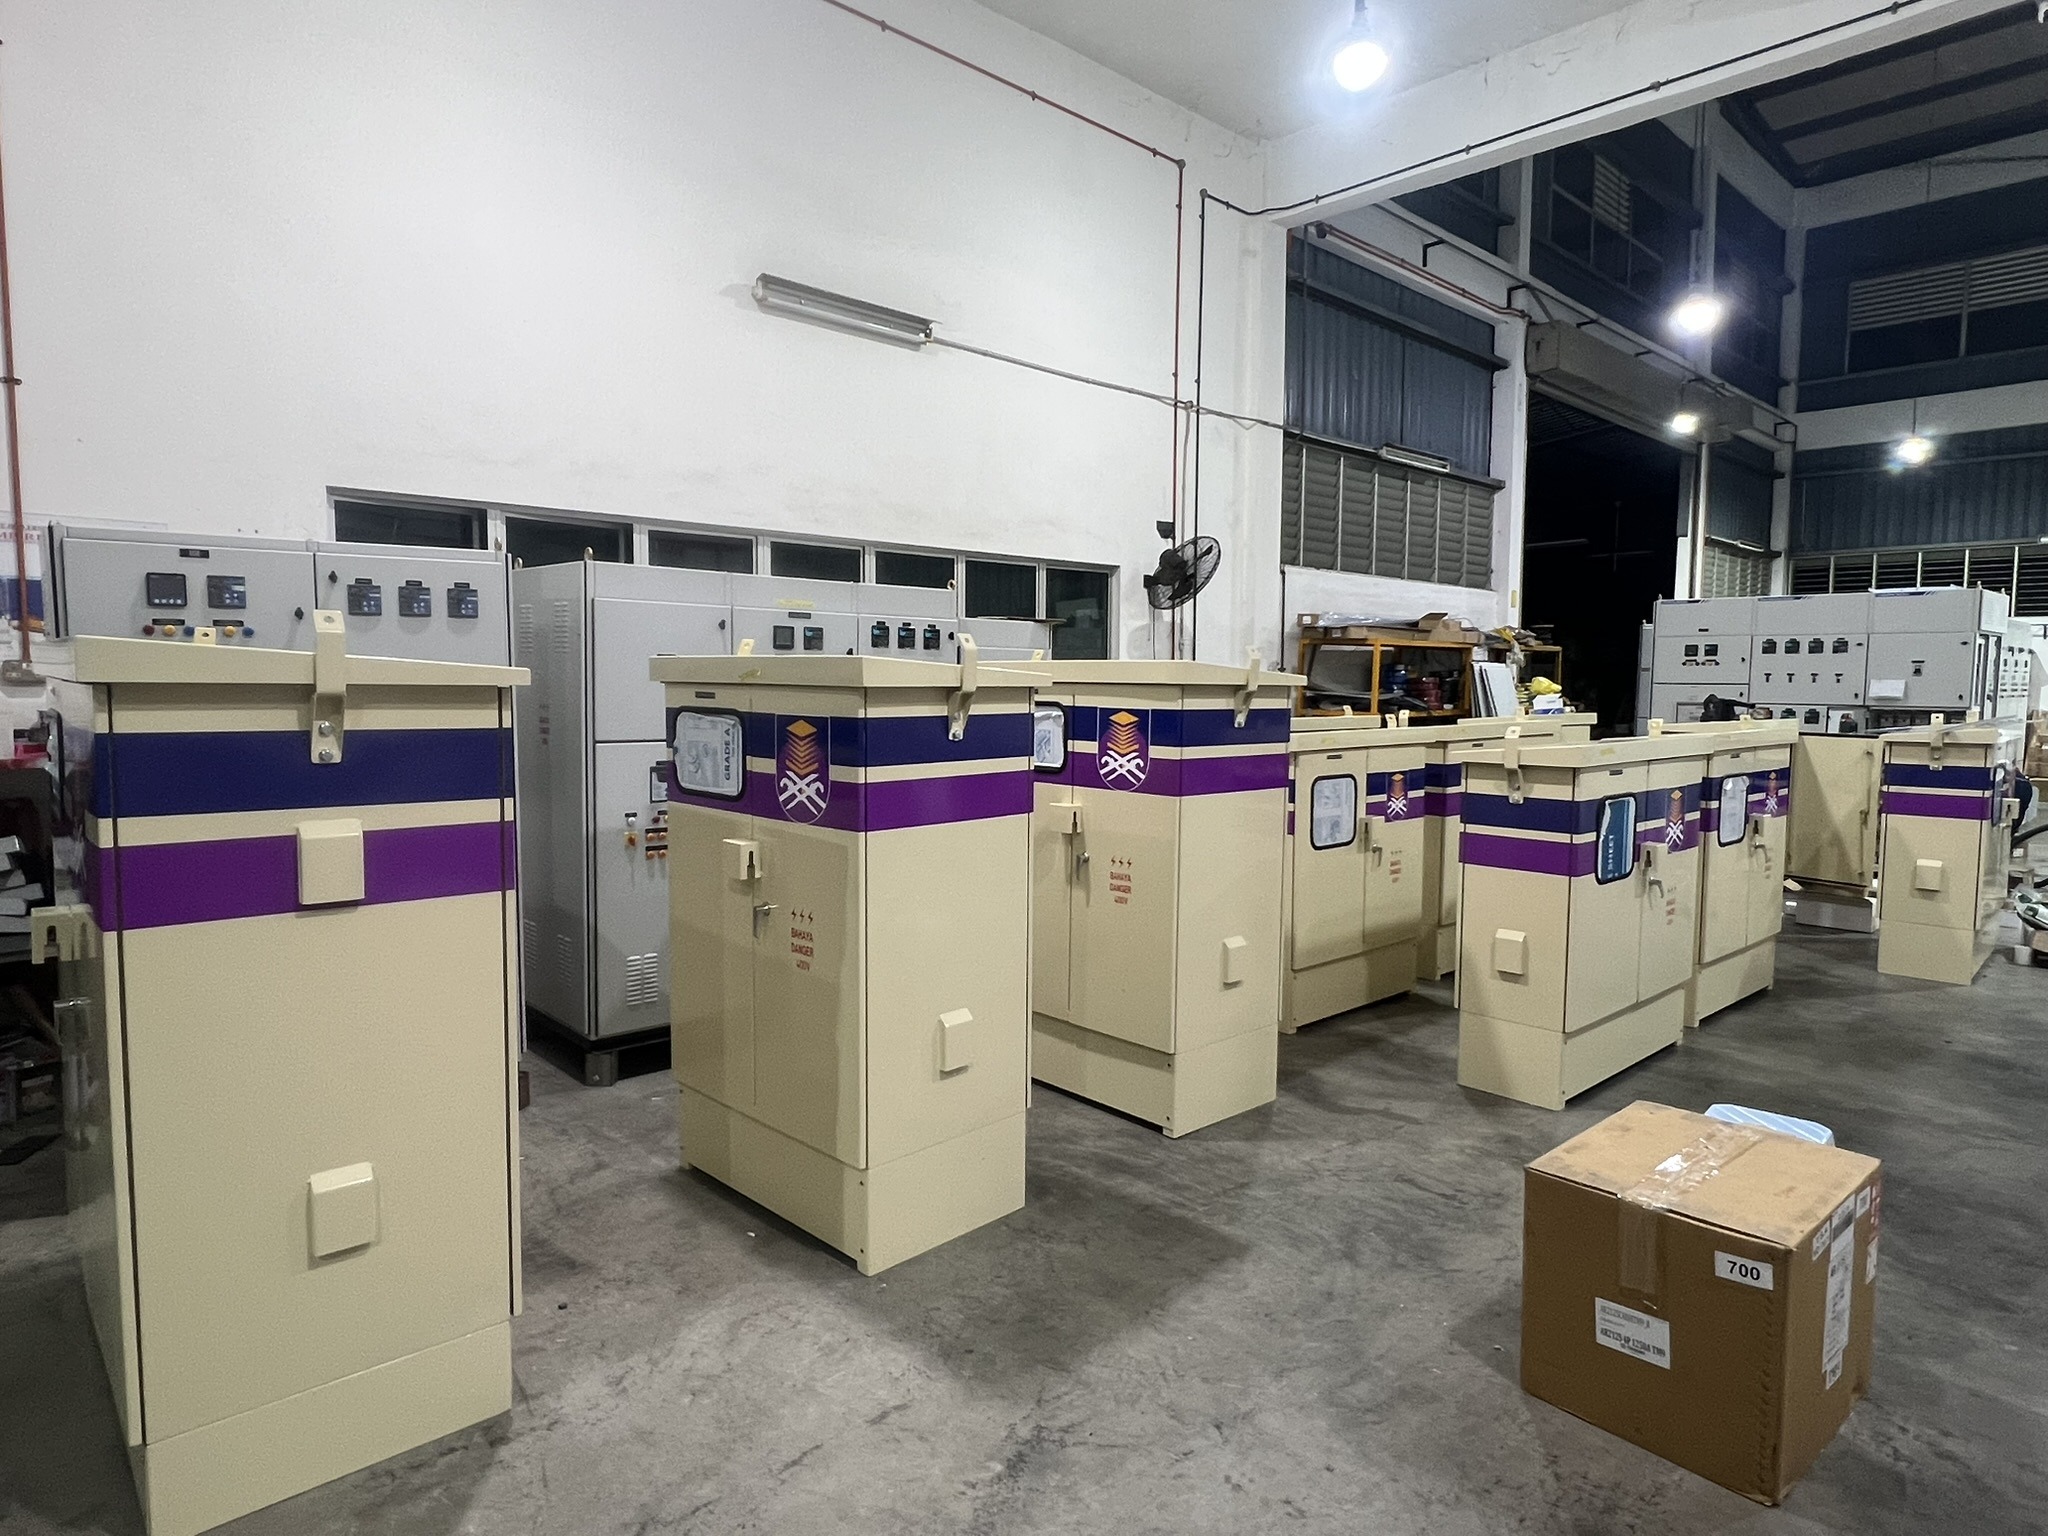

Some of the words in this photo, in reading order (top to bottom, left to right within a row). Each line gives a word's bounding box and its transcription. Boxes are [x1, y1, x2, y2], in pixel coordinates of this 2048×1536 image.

[724, 728, 731, 736] A
[1109, 883, 1132, 894] DANGER
[791, 927, 814, 942] BAHAYA
[791, 942, 814, 958] DANGER
[1727, 1260, 1760, 1281] 700
